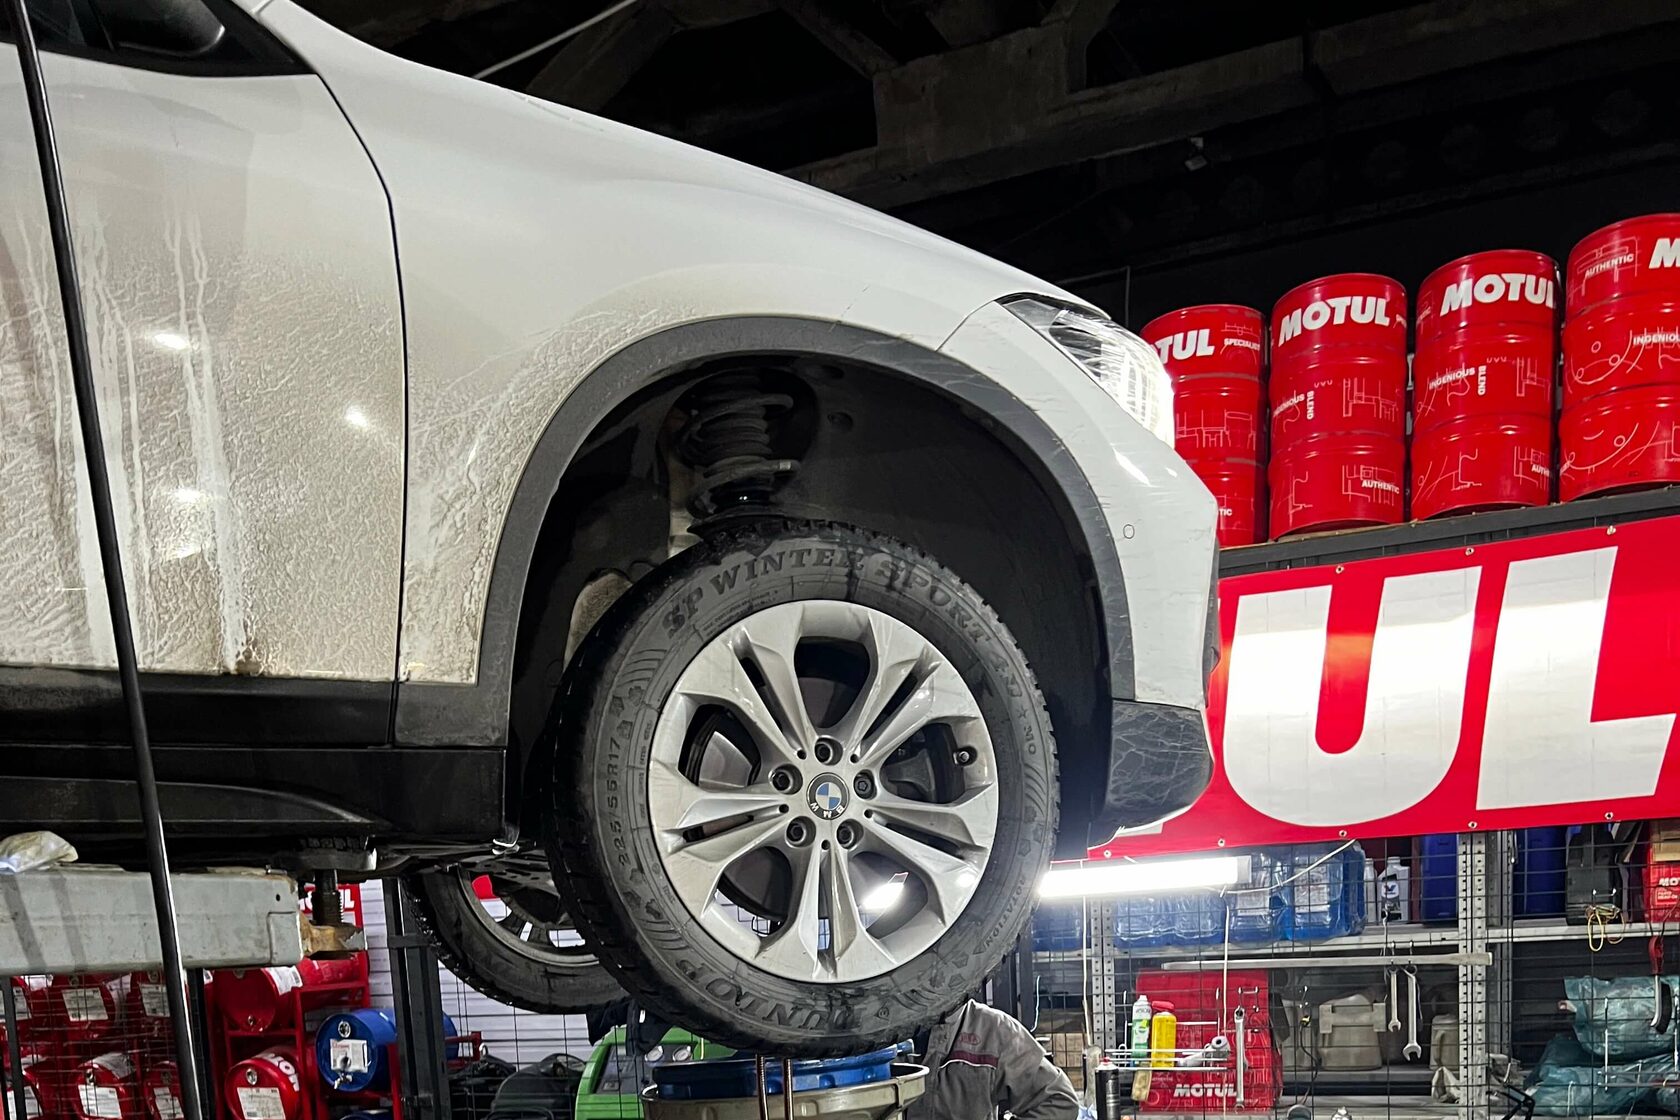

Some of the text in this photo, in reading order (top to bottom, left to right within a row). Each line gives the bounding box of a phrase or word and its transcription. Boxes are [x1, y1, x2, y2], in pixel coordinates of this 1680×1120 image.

[1584, 252, 1634, 278] AUTHENTIC
[1278, 295, 1391, 347] MOTUL
[1157, 328, 1216, 365] TUL
[1633, 331, 1680, 347] INGENIOU
[1428, 365, 1476, 391] INGENIOUS
[1478, 365, 1487, 396] BLEND
[1306, 390, 1315, 420] BLEND
[1361, 479, 1400, 495] AUTHENTIC
[709, 546, 865, 596] WINTER
[1174, 1083, 1237, 1098] MOTUL
